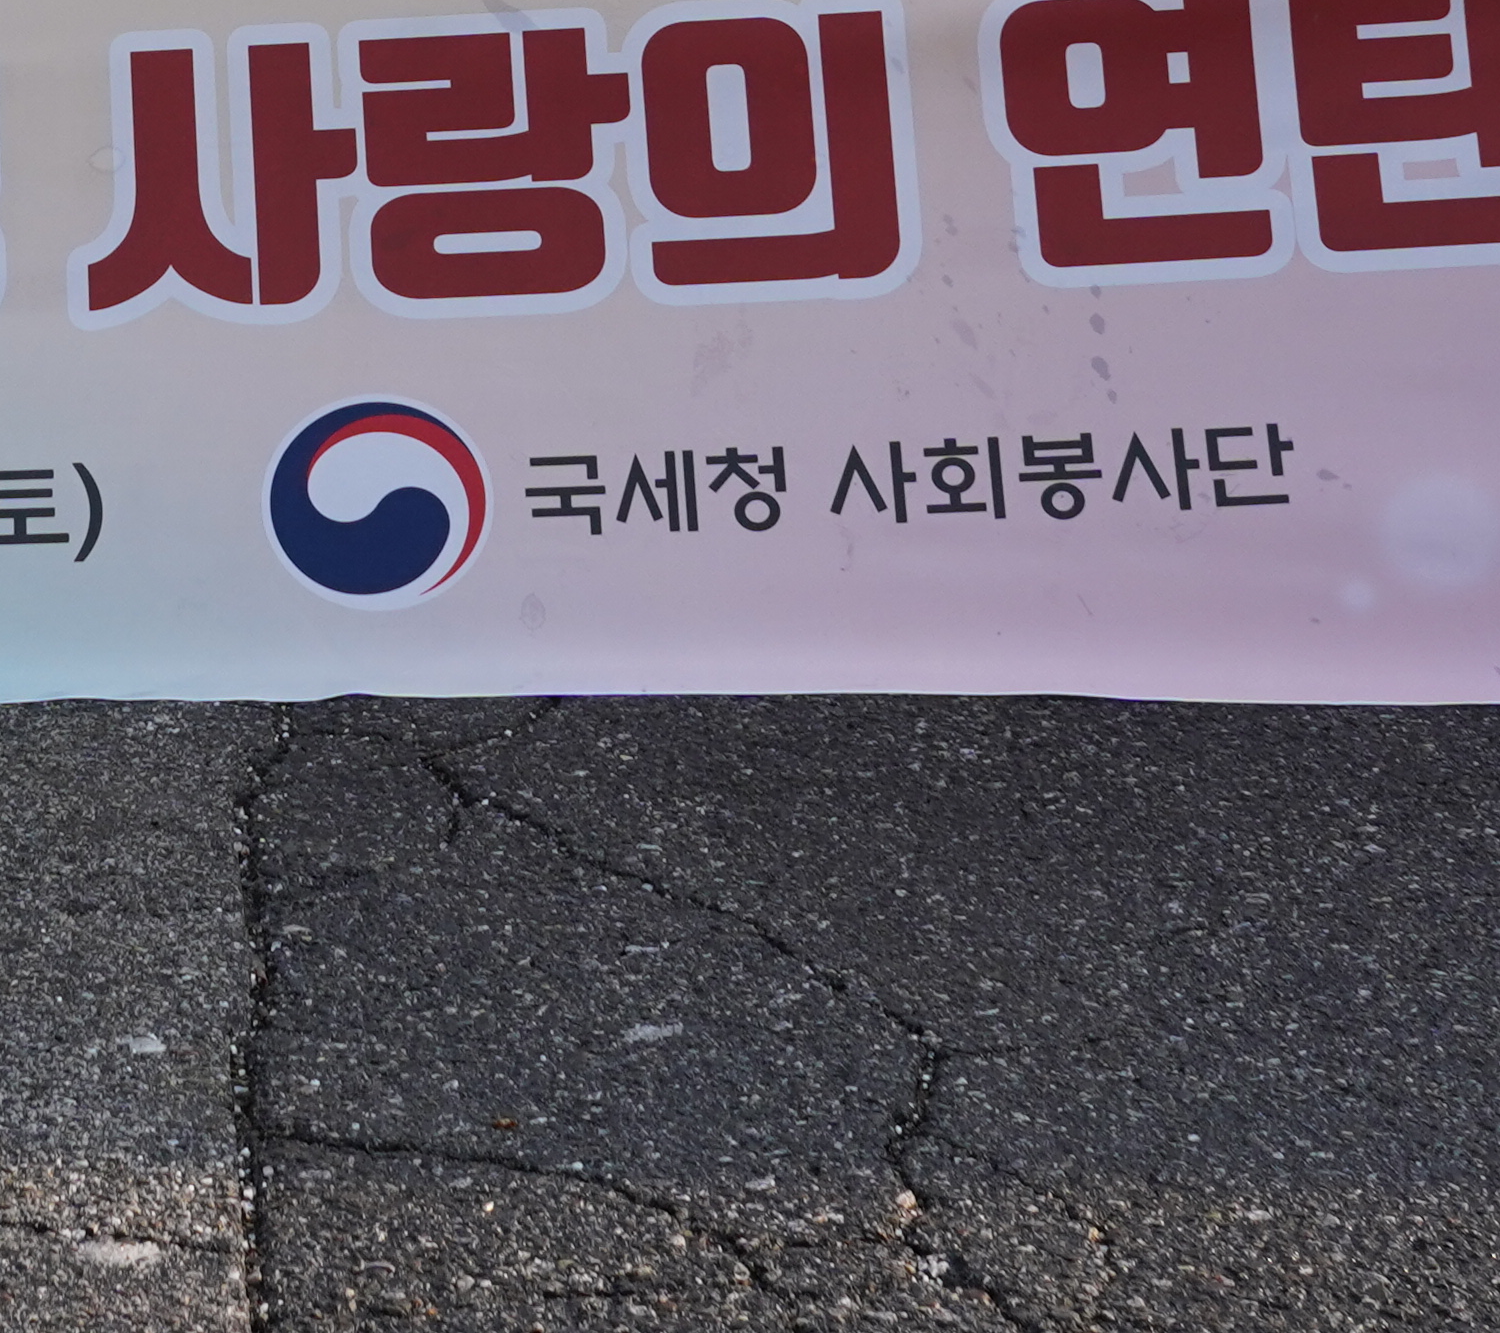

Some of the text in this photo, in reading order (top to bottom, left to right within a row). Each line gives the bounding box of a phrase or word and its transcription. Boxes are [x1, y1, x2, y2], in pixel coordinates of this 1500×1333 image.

[91, 12, 899, 309] 사랑의
[526, 424, 1293, 535] 국세청 사회봉사단
